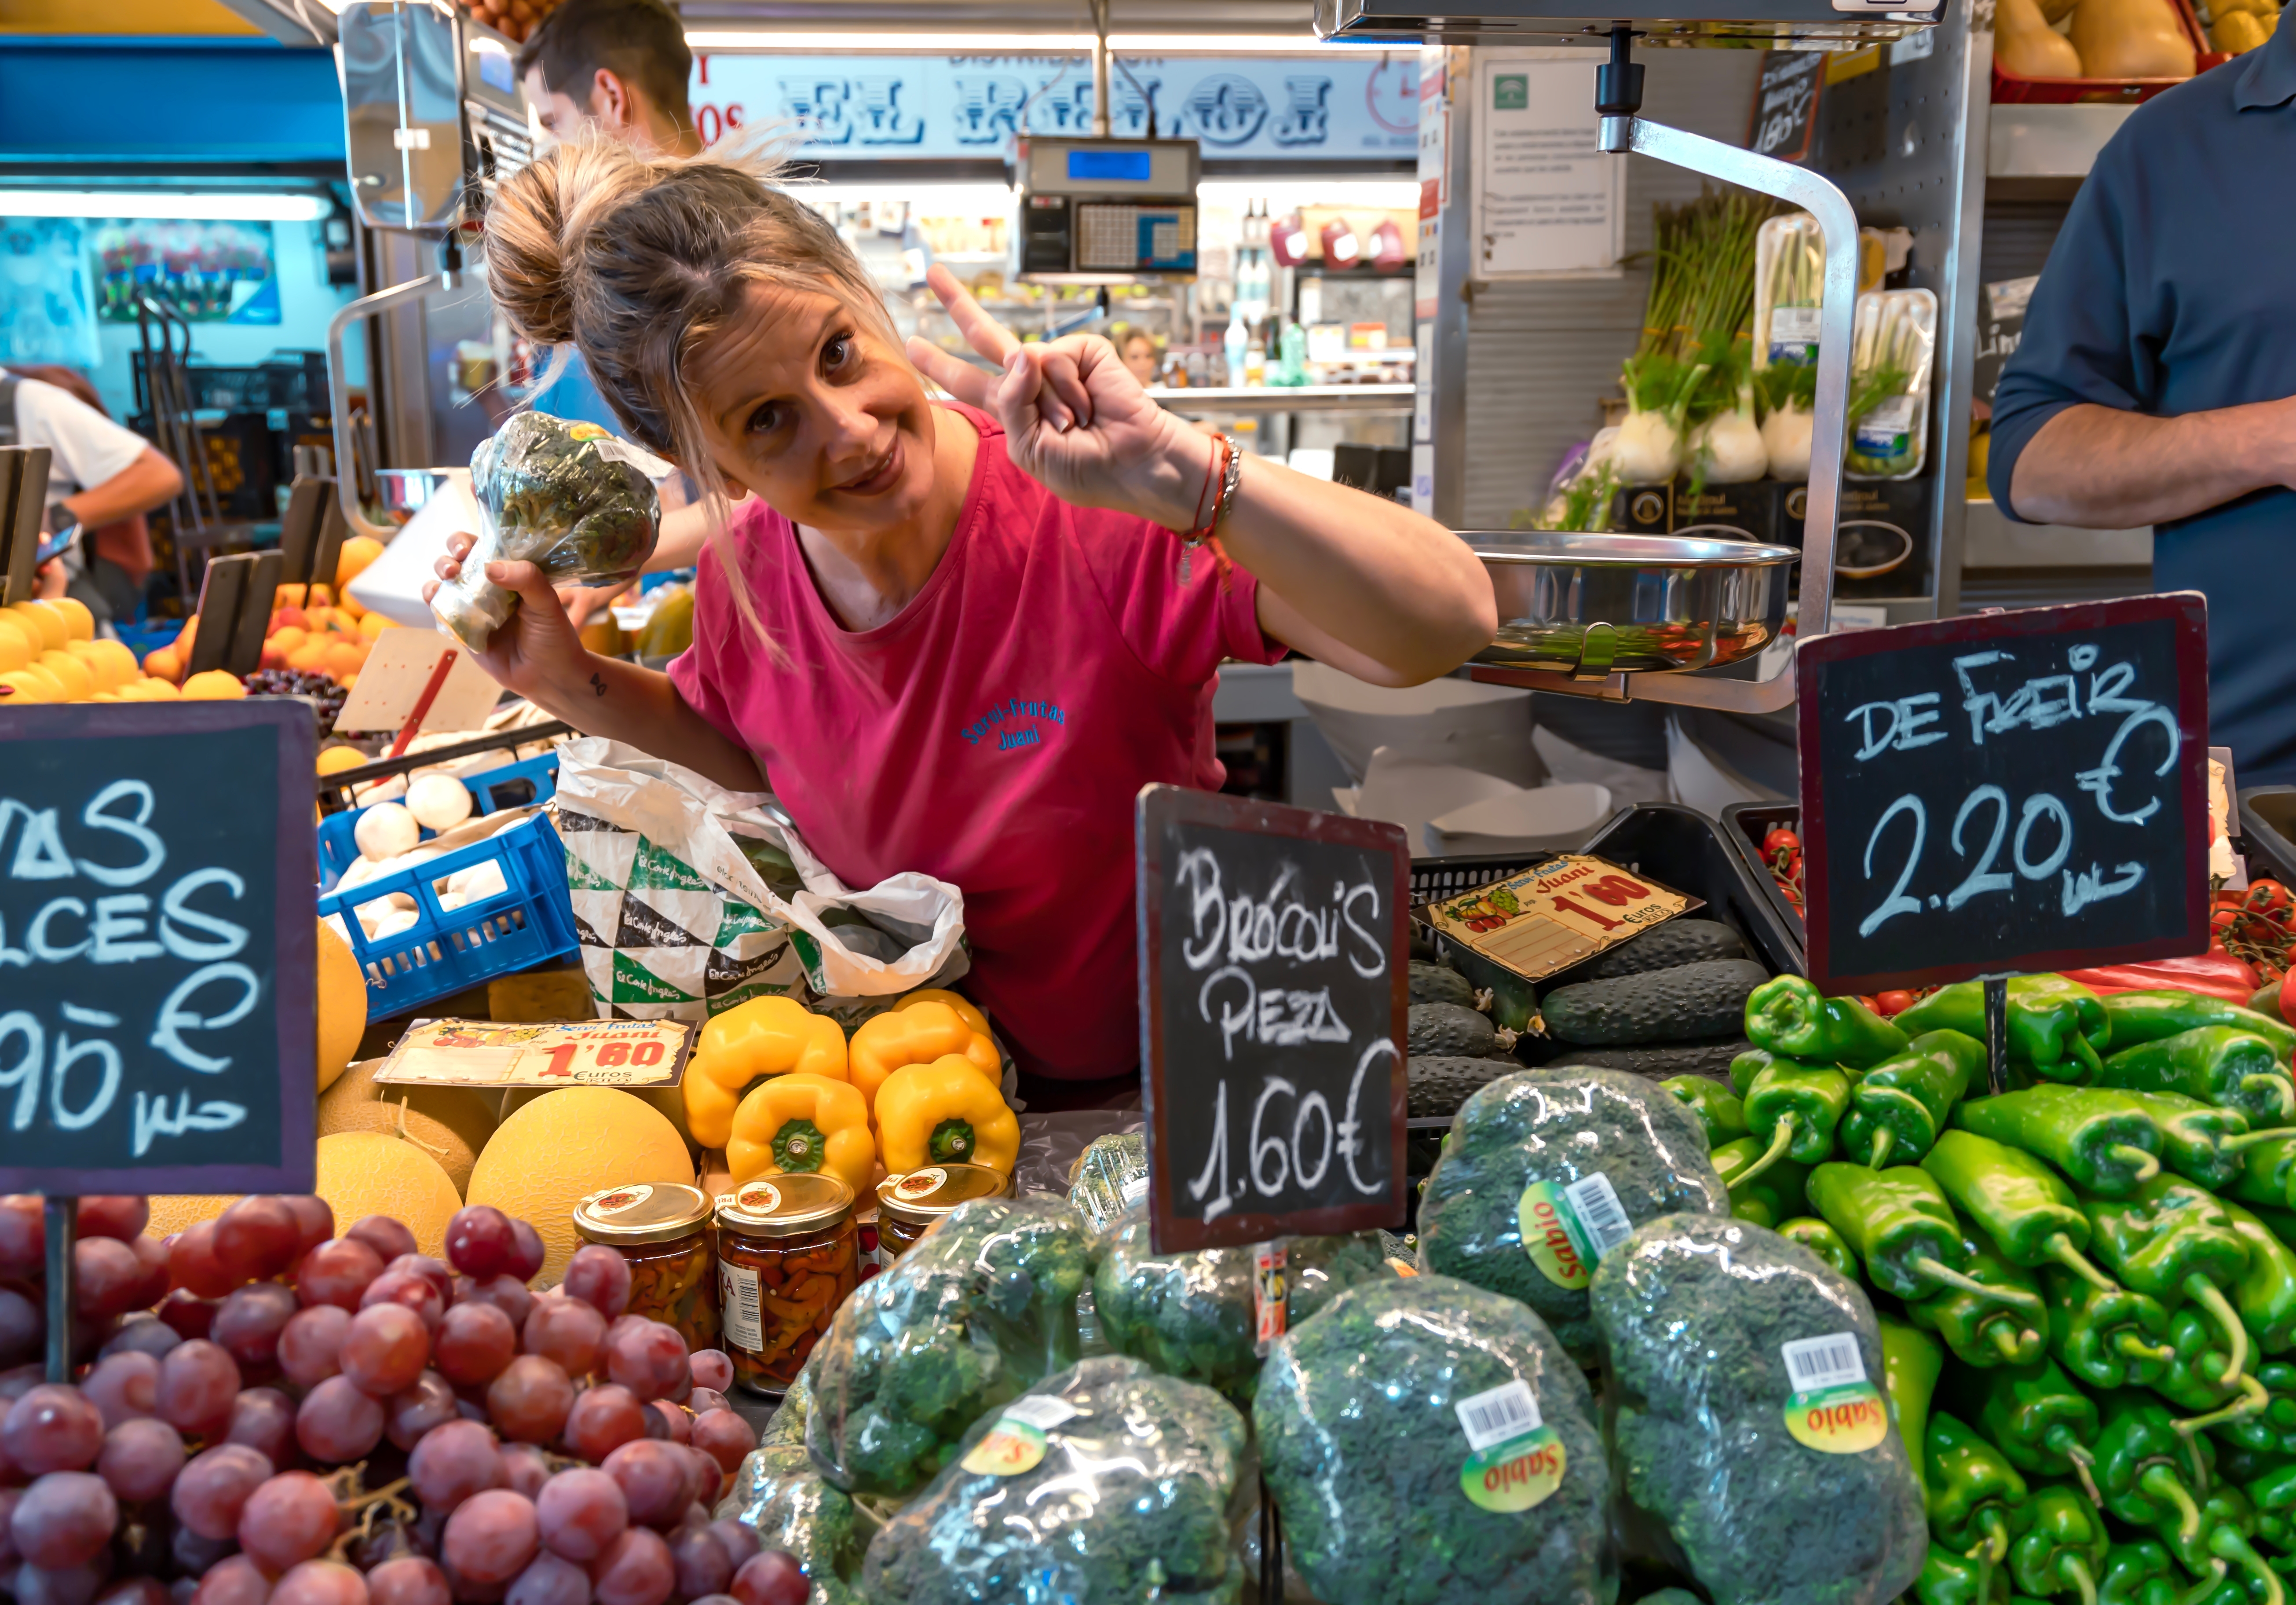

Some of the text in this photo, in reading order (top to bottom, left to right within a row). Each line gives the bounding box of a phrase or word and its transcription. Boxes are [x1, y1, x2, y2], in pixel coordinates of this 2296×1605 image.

[775, 73, 1334, 150] EL RELOJ
[998, 724, 1040, 750] Juani
[1845, 692, 1949, 761] DE
[1536, 862, 1596, 894] Juani
[1644, 909, 1672, 922] KILO
[564, 1029, 663, 1040] Juani
[1533, 1202, 1587, 1279] Sabio
[1807, 1398, 1881, 1436] Sabio
[1483, 1444, 1559, 1494] Sabio
